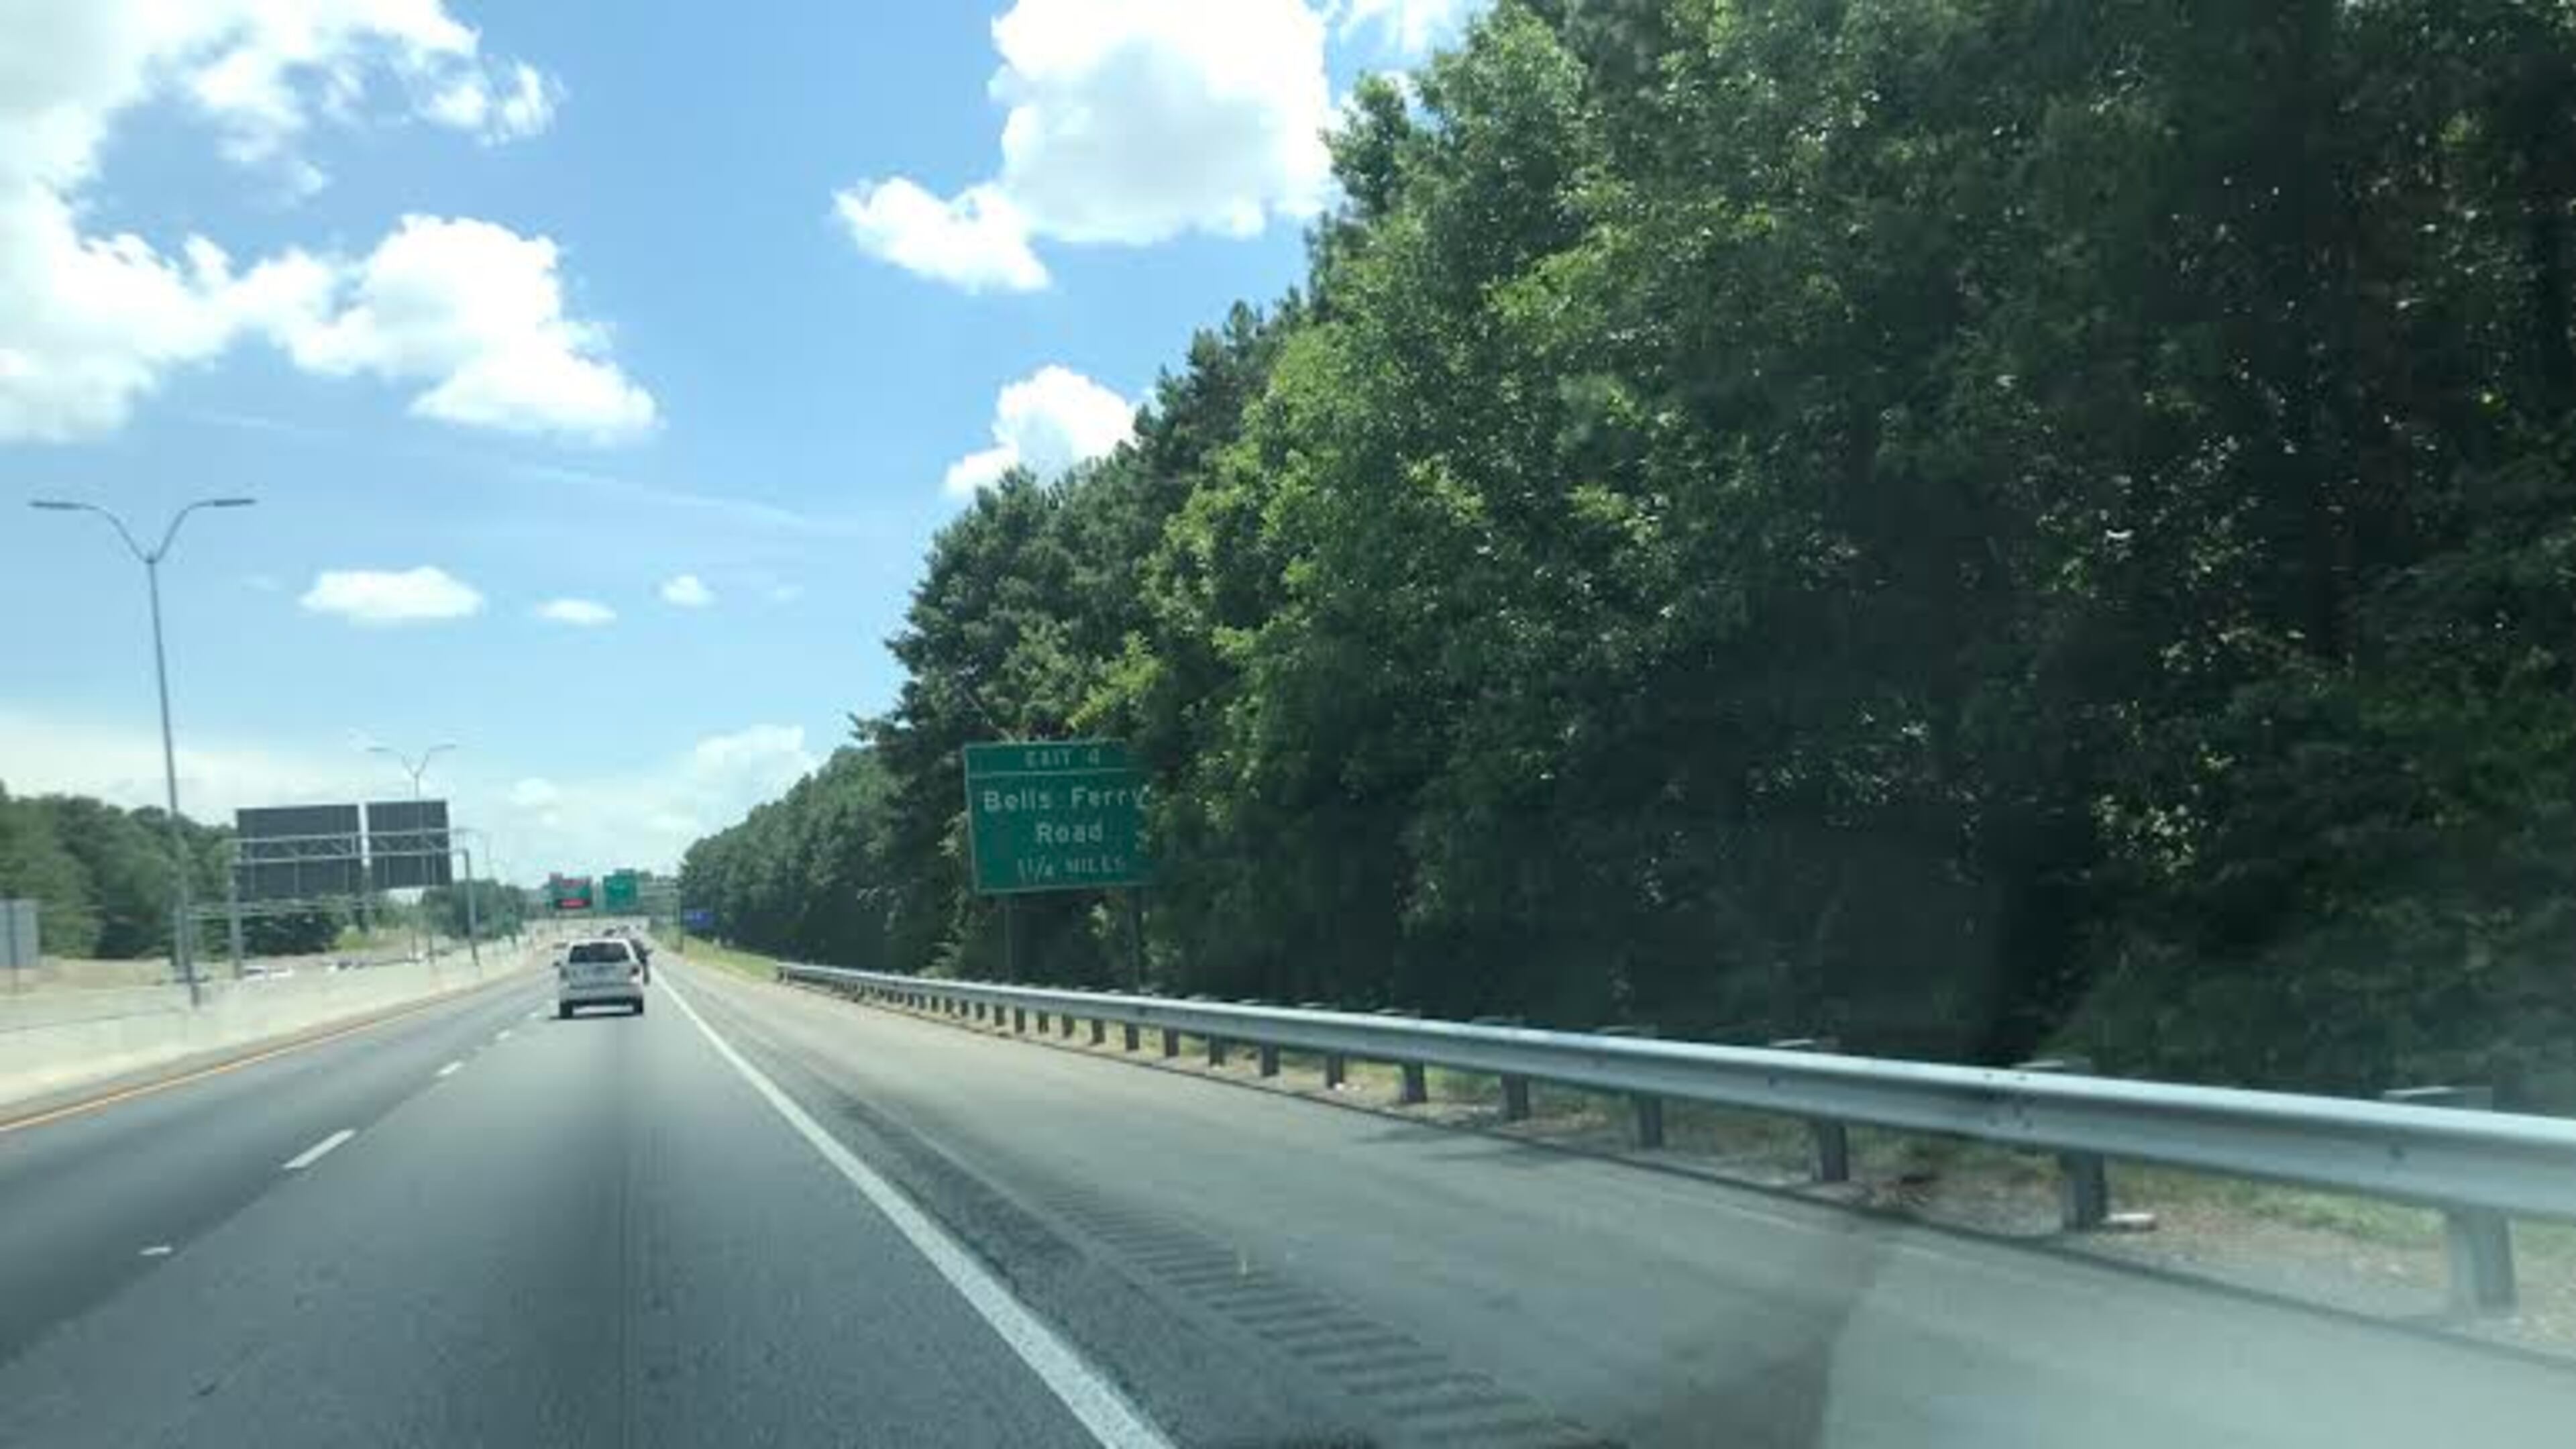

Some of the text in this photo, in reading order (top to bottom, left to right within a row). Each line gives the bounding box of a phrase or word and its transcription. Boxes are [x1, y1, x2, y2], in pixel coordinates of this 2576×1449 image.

[1025, 749, 1072, 767] EXIT
[983, 786, 1147, 812] Bells Ferry
[1036, 818, 1103, 845] Road
